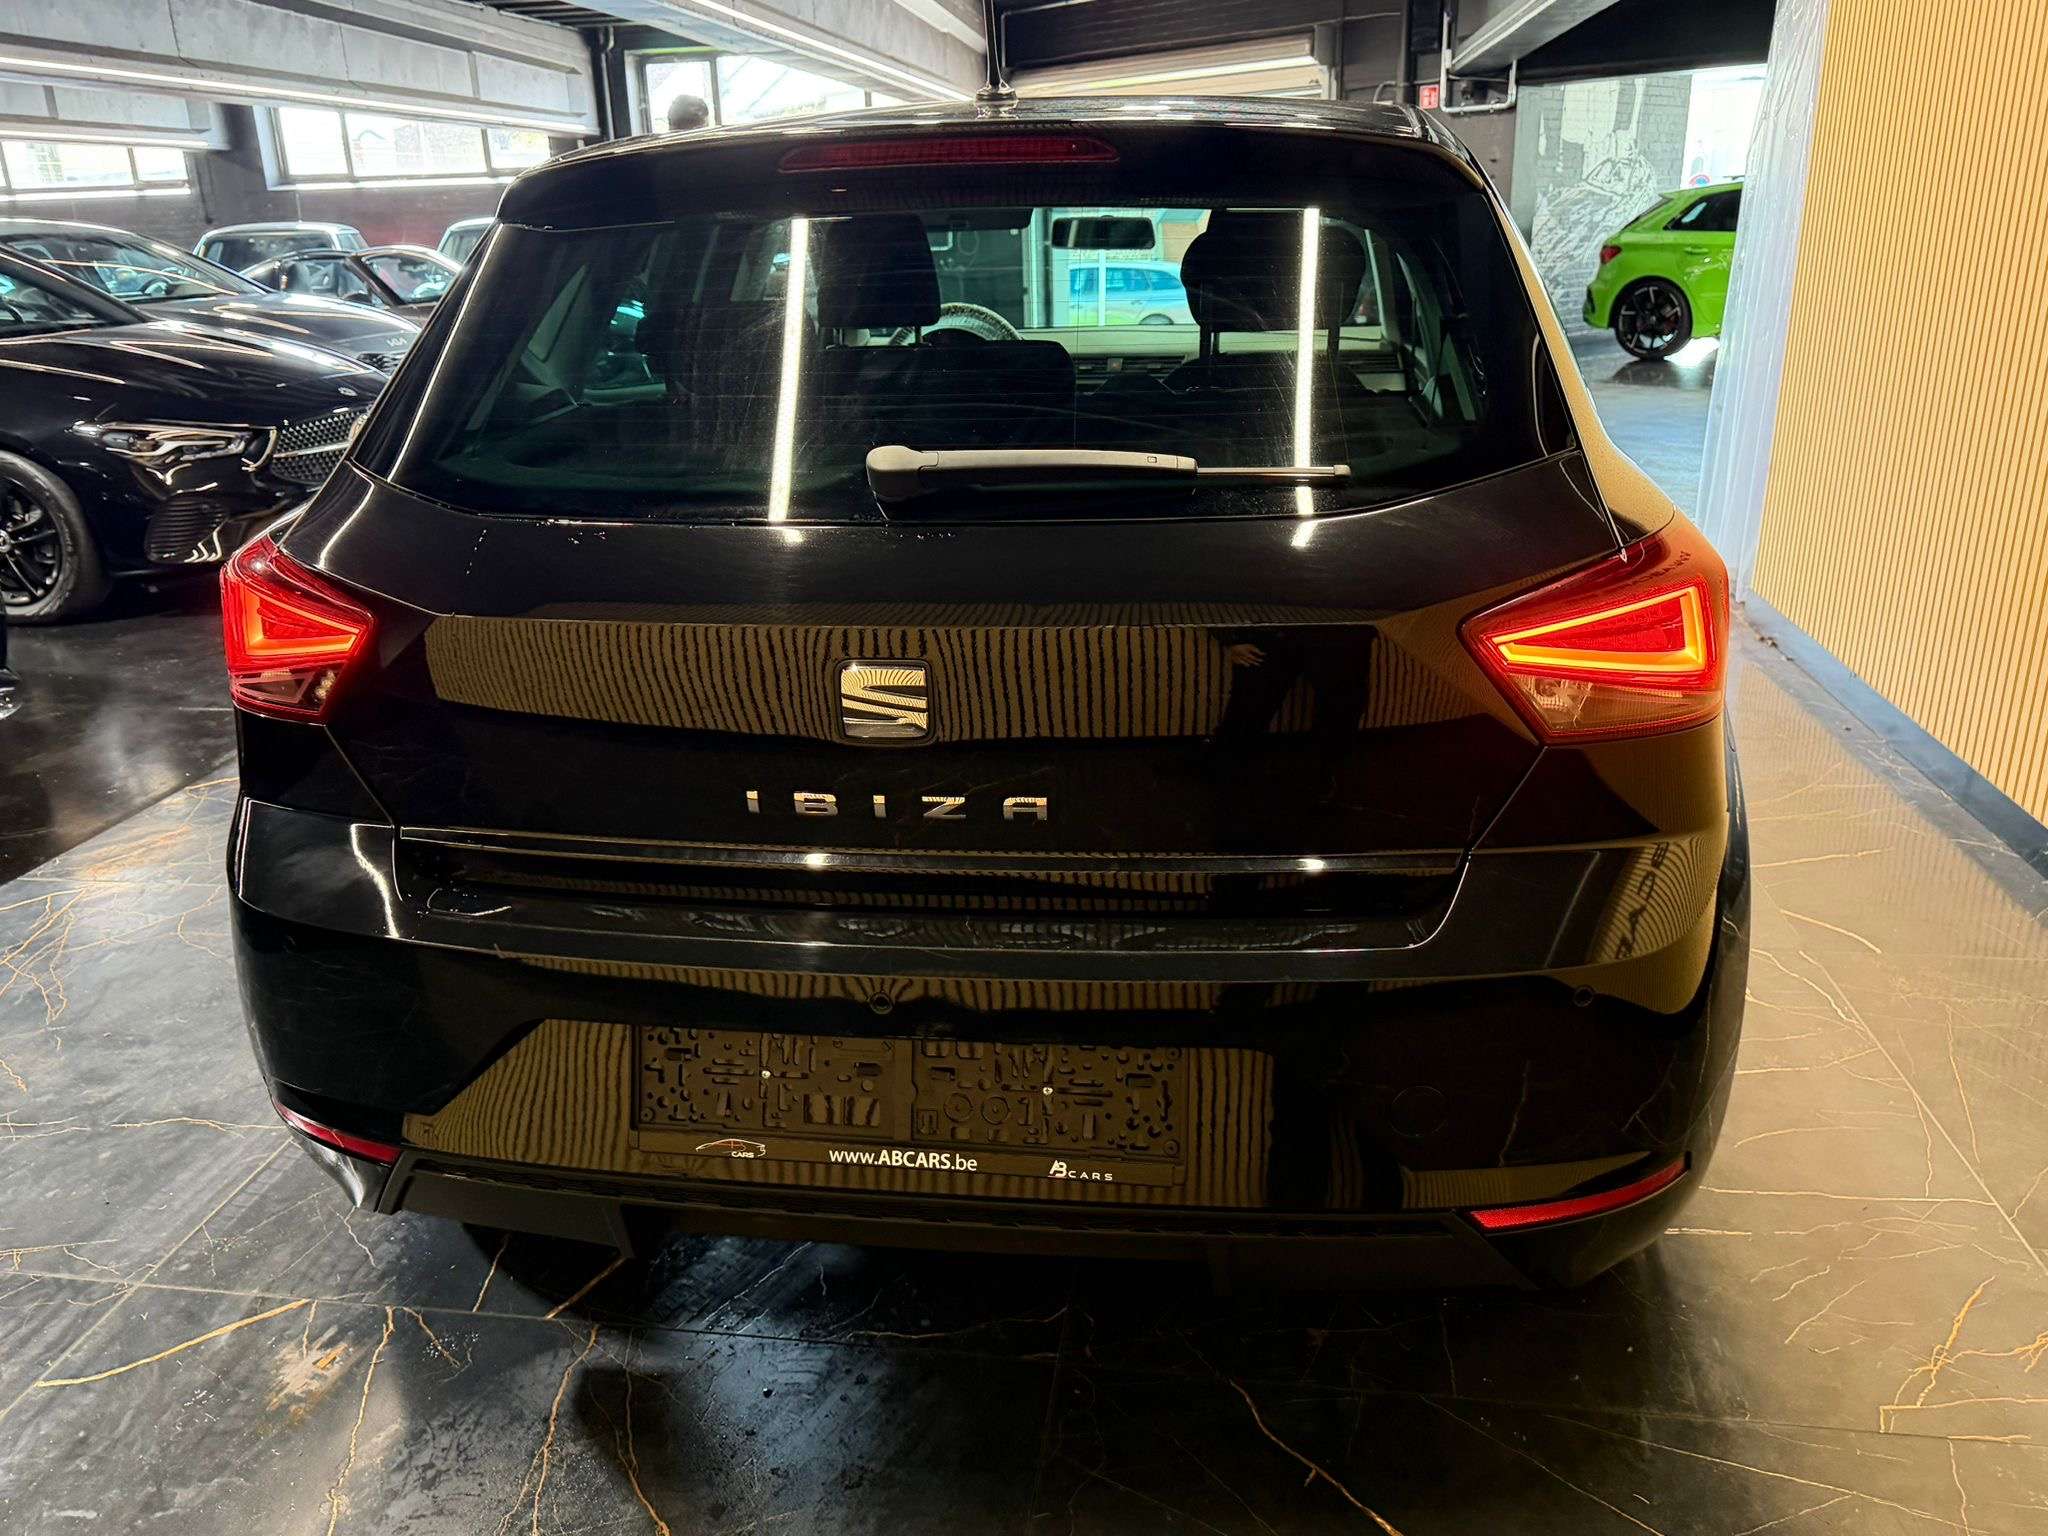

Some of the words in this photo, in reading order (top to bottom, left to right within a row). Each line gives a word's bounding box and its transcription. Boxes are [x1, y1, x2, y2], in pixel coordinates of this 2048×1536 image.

[746, 790, 1048, 821] IBIZA
[731, 1151, 755, 1159] CARS
[828, 1149, 978, 1171] www.ABCARS.be
